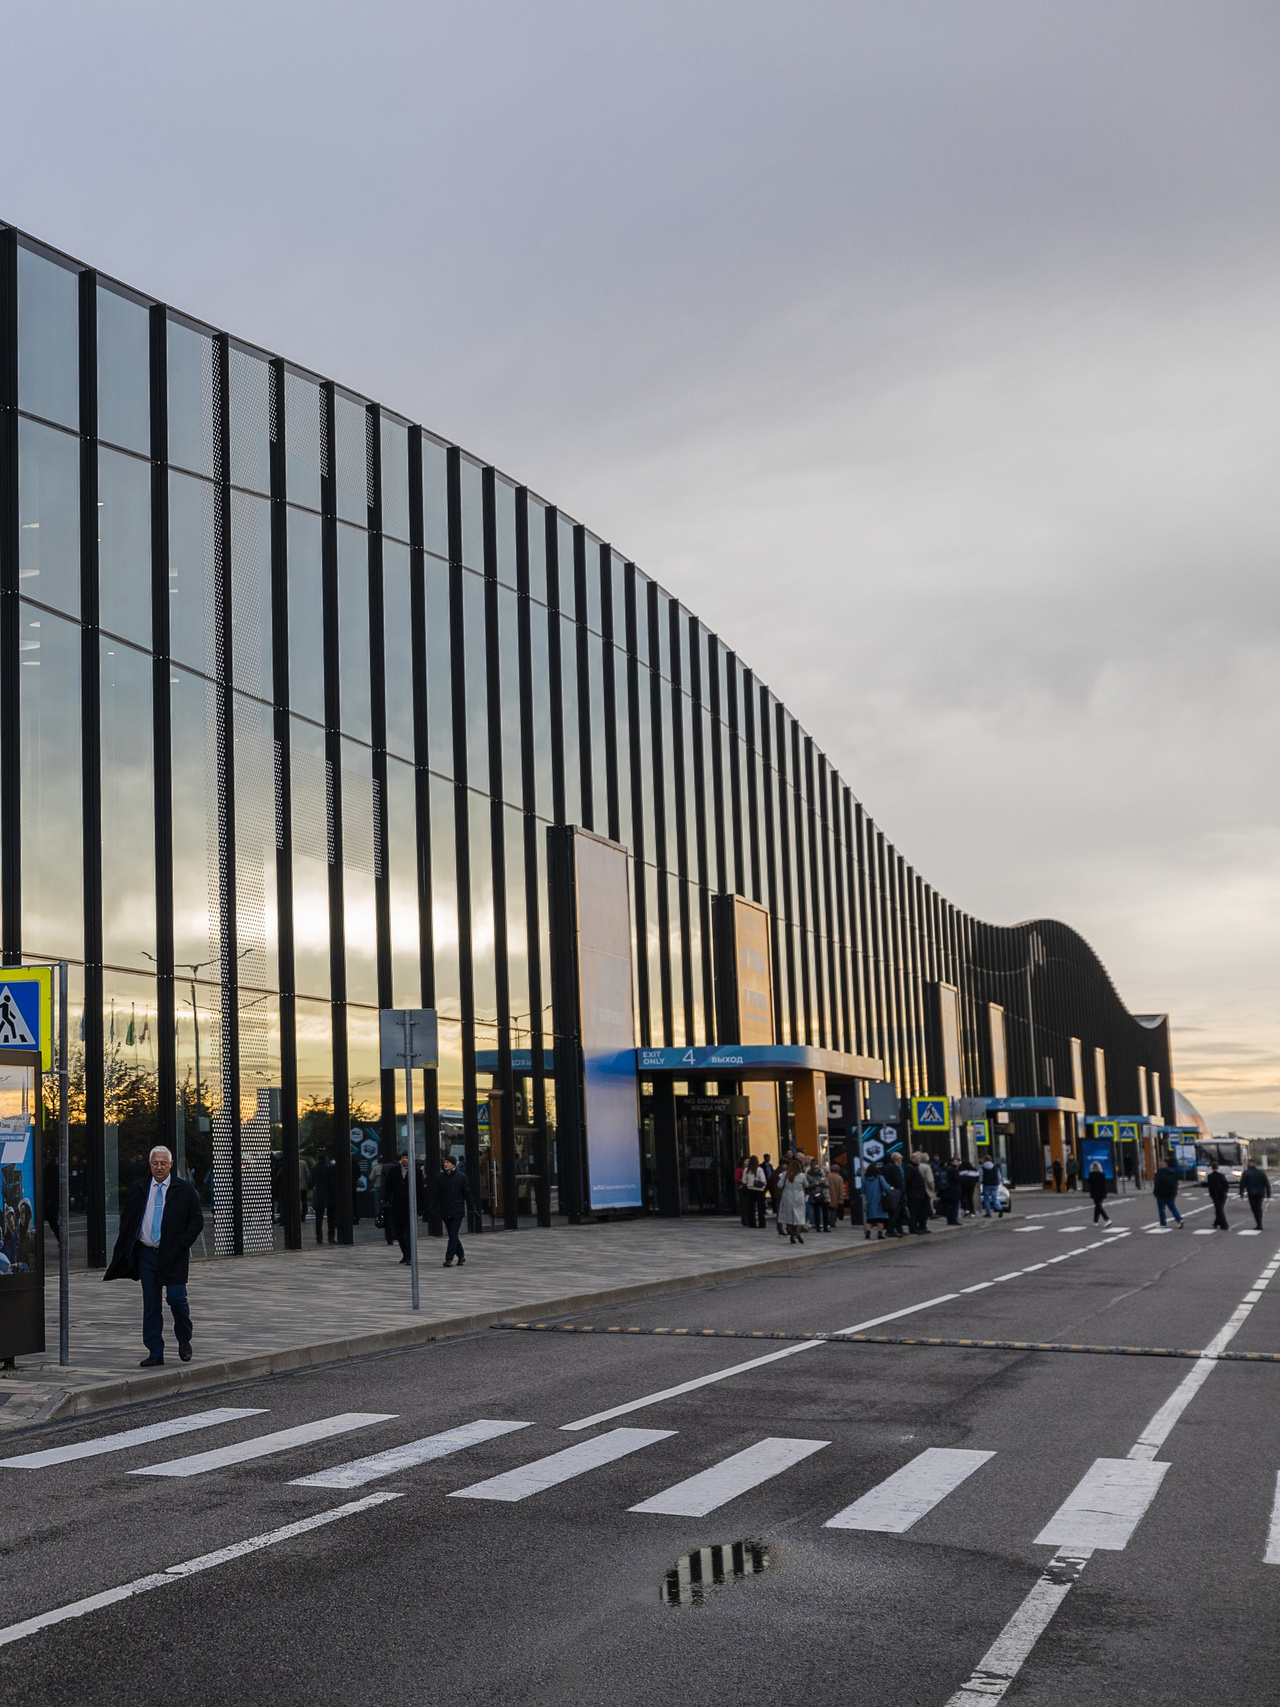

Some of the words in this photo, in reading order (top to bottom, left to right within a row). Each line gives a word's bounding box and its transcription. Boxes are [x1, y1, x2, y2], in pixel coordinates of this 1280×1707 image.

[682, 1049, 696, 1065] 4
[711, 1056, 743, 1065] ВЫХОД
[827, 1094, 843, 1119] G
